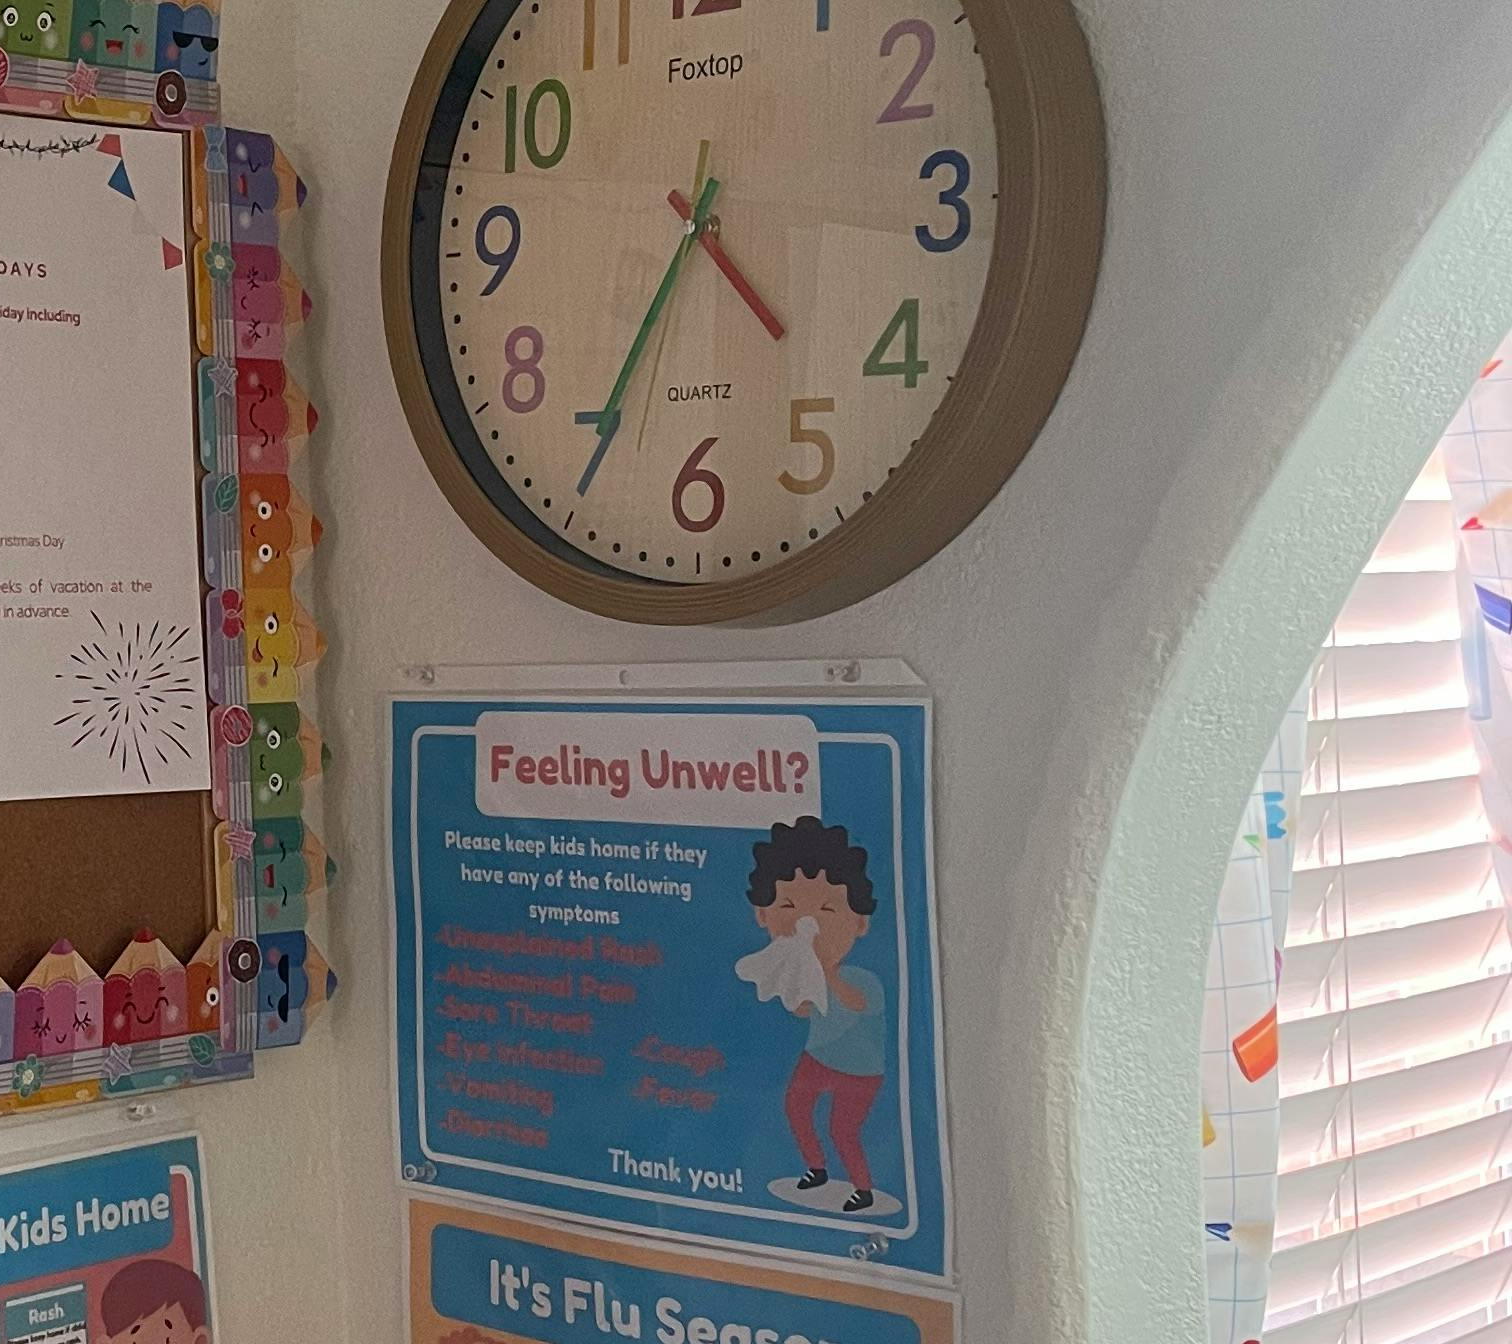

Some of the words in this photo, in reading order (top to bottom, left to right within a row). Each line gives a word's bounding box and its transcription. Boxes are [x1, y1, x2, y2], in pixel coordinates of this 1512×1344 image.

[667, 51, 744, 83] Foxtop
[876, 18, 936, 124] 2
[503, 79, 571, 173] 10
[914, 149, 971, 253] 3
[474, 205, 522, 297] 9
[501, 325, 546, 414] 8
[861, 298, 929, 389] 4
[667, 383, 732, 402] QUARTZ
[574, 410, 621, 497] 7
[777, 397, 835, 495] 5
[670, 436, 725, 533] 6
[50, 582, 103, 593] vacation
[490, 745, 630, 798] Feeling
[641, 749, 809, 794] Unwell?
[445, 830, 501, 852] Please
[505, 832, 545, 858] keep
[550, 836, 585, 857] kids
[590, 838, 640, 859] home
[664, 842, 707, 868] they
[461, 864, 504, 885] have
[508, 870, 540, 890] any
[545, 870, 564, 888] of
[569, 871, 599, 891] the
[604, 872, 692, 901] following
[529, 904, 620, 926] symptoms
[608, 1148, 680, 1183] Thank
[688, 1168, 743, 1192] you!
[76, 1191, 170, 1237] Home
[29, 1302, 64, 1325] Rash
[490, 1258, 551, 1318] It's
[563, 1277, 640, 1339] Flu
